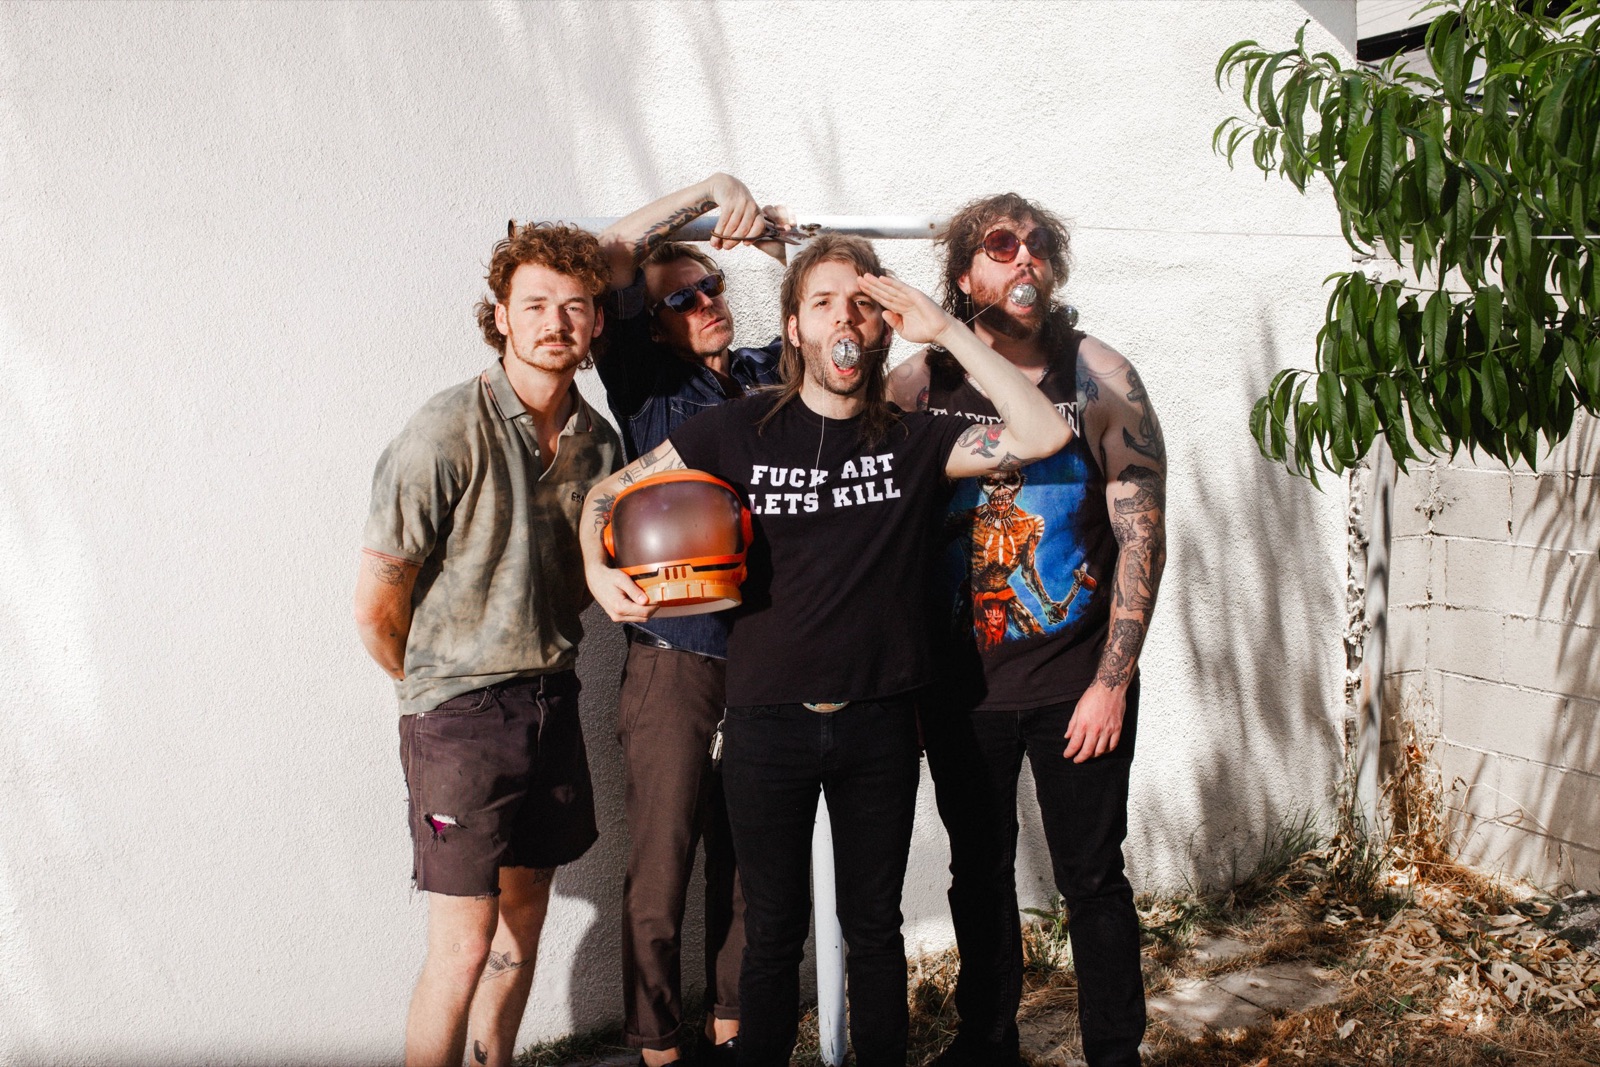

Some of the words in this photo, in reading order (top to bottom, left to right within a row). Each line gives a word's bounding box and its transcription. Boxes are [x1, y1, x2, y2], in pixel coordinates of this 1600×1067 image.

[750, 464, 829, 488] FUCK
[841, 452, 894, 479] ART
[748, 492, 819, 514] LETS
[832, 477, 901, 508] KILL
